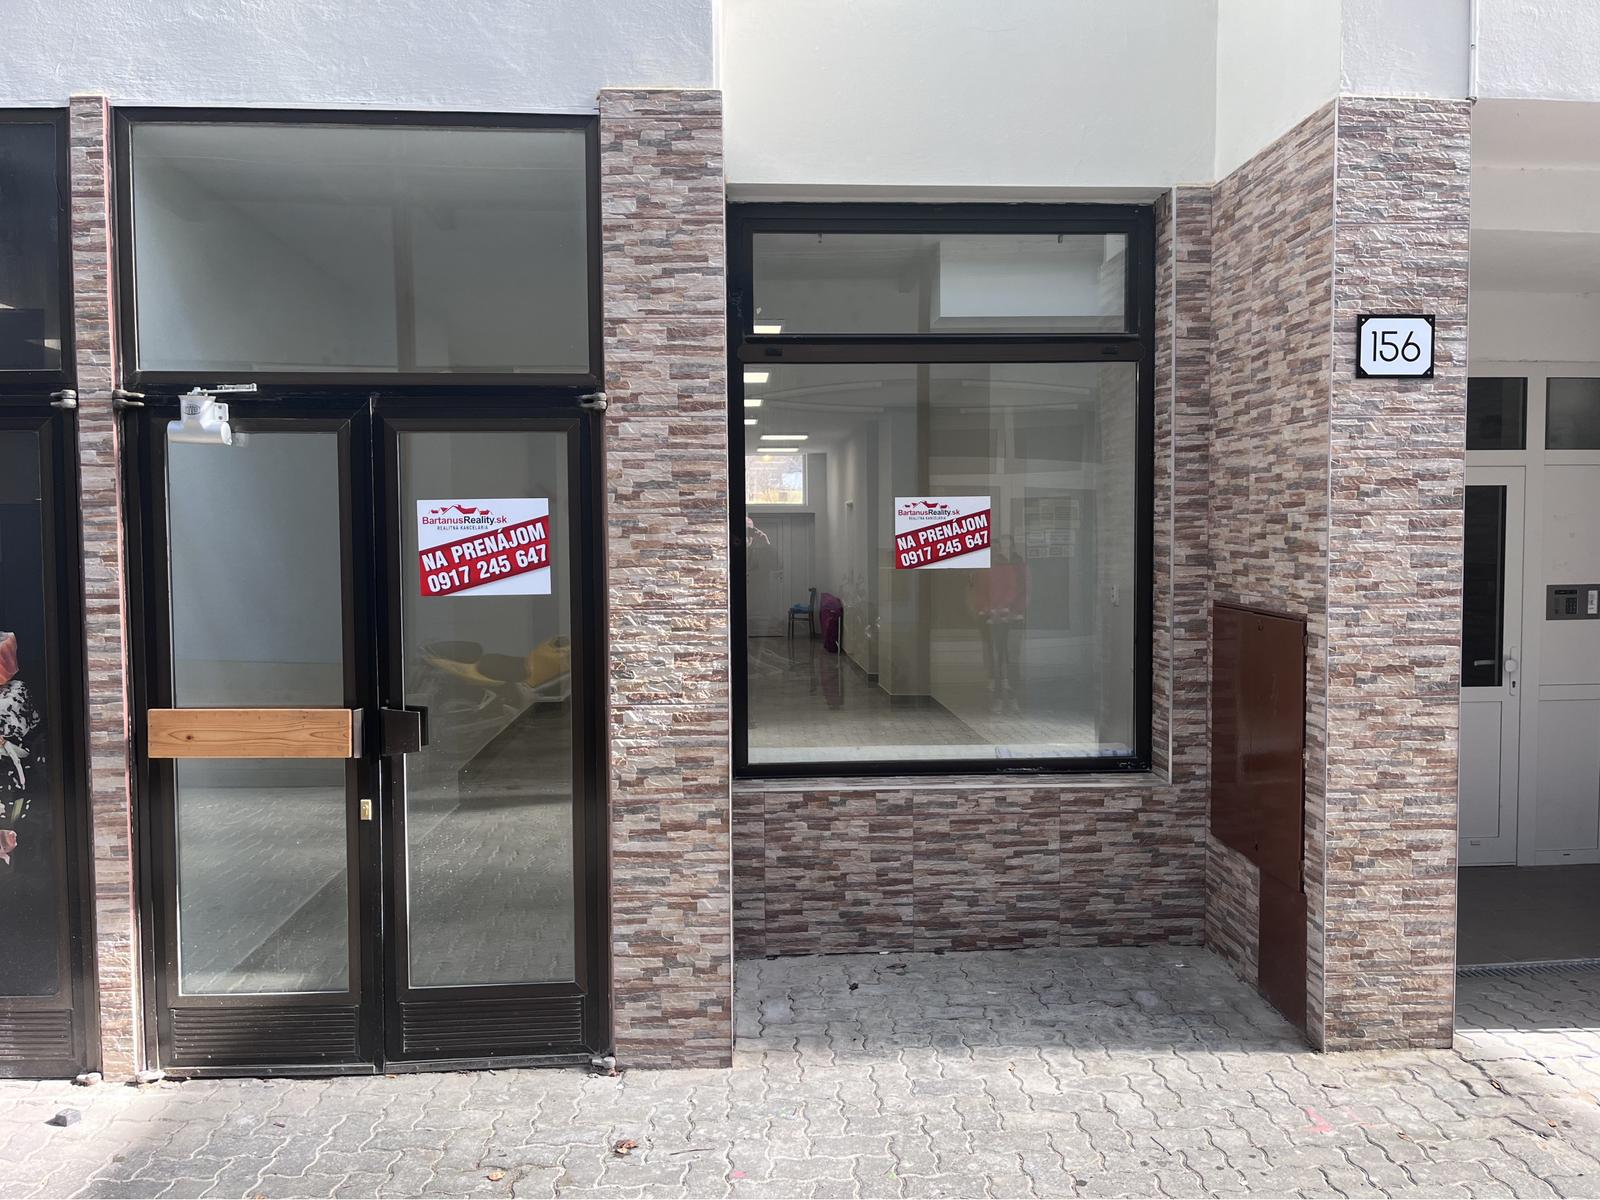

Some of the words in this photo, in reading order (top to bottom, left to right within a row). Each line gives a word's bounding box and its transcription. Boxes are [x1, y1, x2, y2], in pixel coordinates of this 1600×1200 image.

[1372, 331, 1421, 362] 156
[422, 515, 508, 526] BartanusReality.sk
[898, 509, 960, 517] BartanusReality.sk
[421, 550, 449, 572] NA
[451, 522, 546, 563] PRENÁJOM
[896, 535, 916, 551] NA
[918, 514, 988, 545] PRENÁJOM
[900, 546, 932, 567] 0917
[937, 539, 962, 557] 245
[965, 530, 988, 548] 647
[427, 565, 470, 593] 0917
[476, 554, 511, 579] 245
[515, 543, 547, 568] 647
